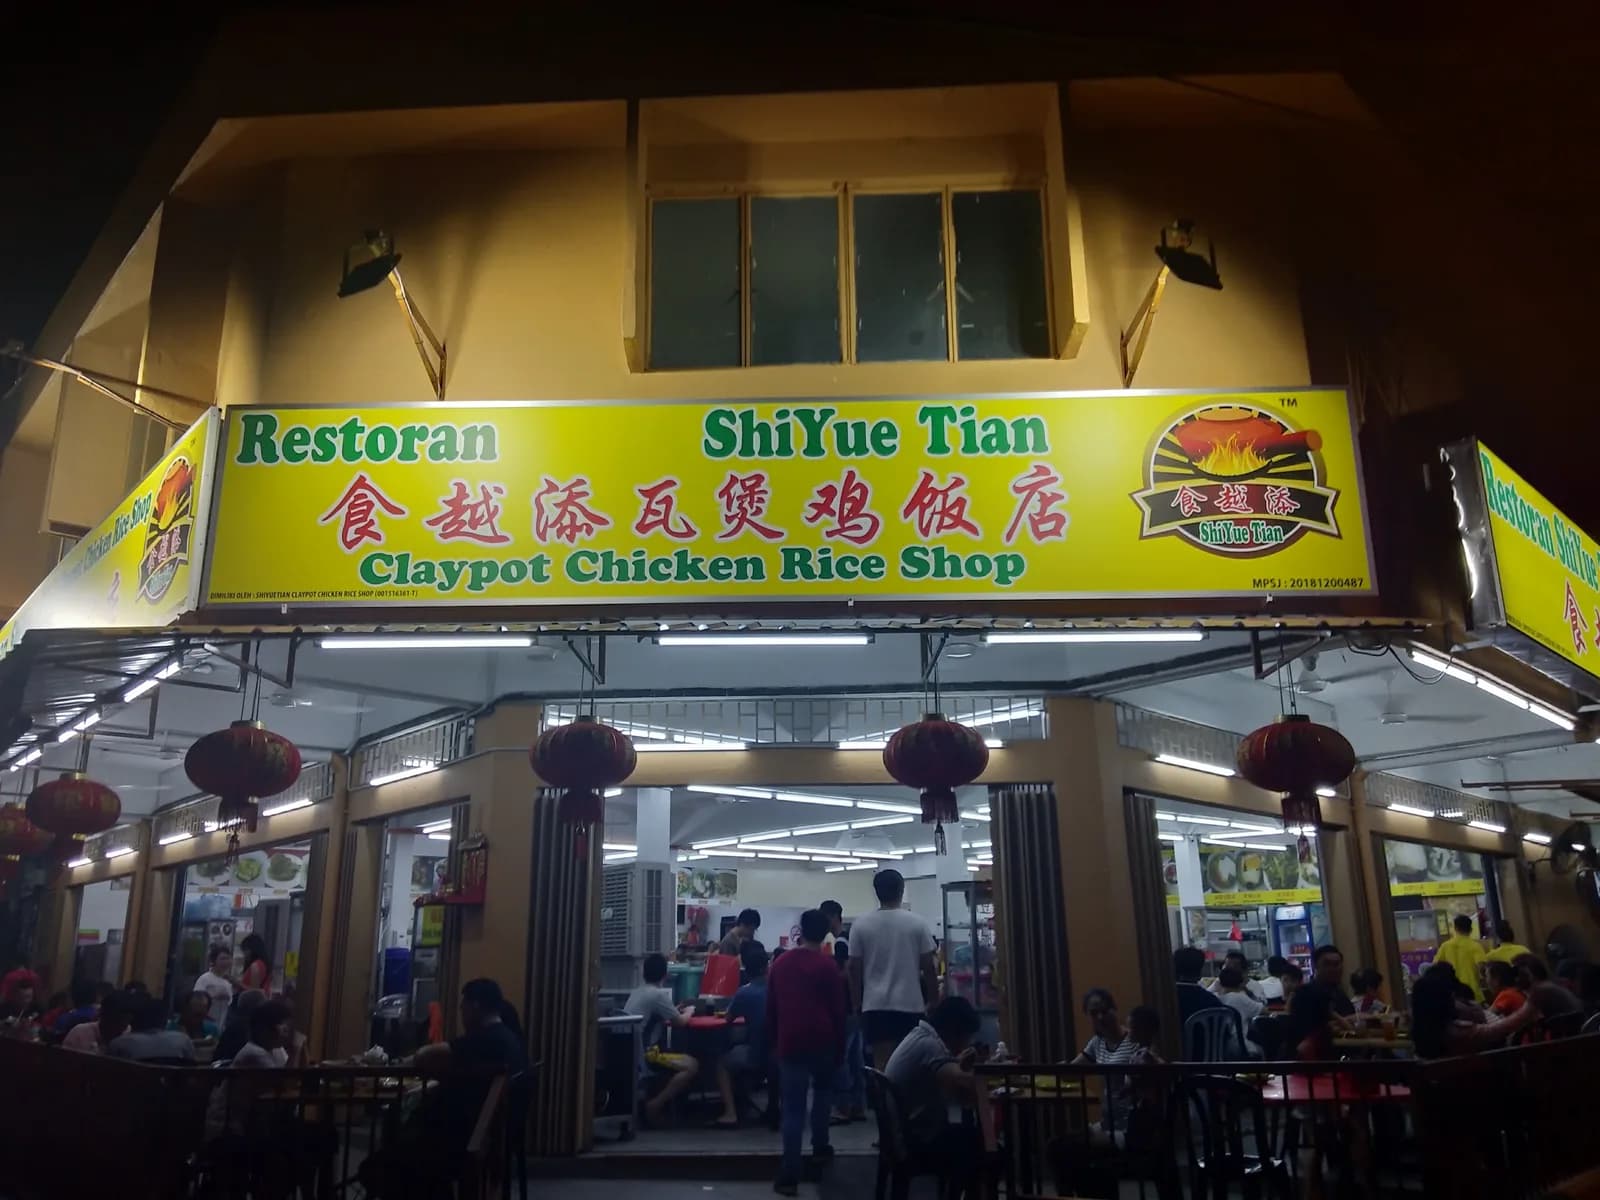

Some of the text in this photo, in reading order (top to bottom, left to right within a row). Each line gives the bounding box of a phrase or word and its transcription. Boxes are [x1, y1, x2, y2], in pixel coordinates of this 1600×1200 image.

[1279, 397, 1297, 408] TM
[237, 404, 1049, 464] Restoran ShiYue Tian
[129, 492, 152, 529] Shop
[322, 464, 1068, 550] 食越添瓦煲鸡饭店
[1171, 484, 1300, 516] 食越添
[1480, 451, 1556, 558] Restoran
[1199, 518, 1284, 544] ShiYue Tian
[360, 544, 1025, 592] Claypot Chicken Rice Shop
[1252, 577, 1281, 589] MPSJ
[1290, 577, 1364, 588] 20181200487
[291, 591, 316, 599] CLAYPOT
